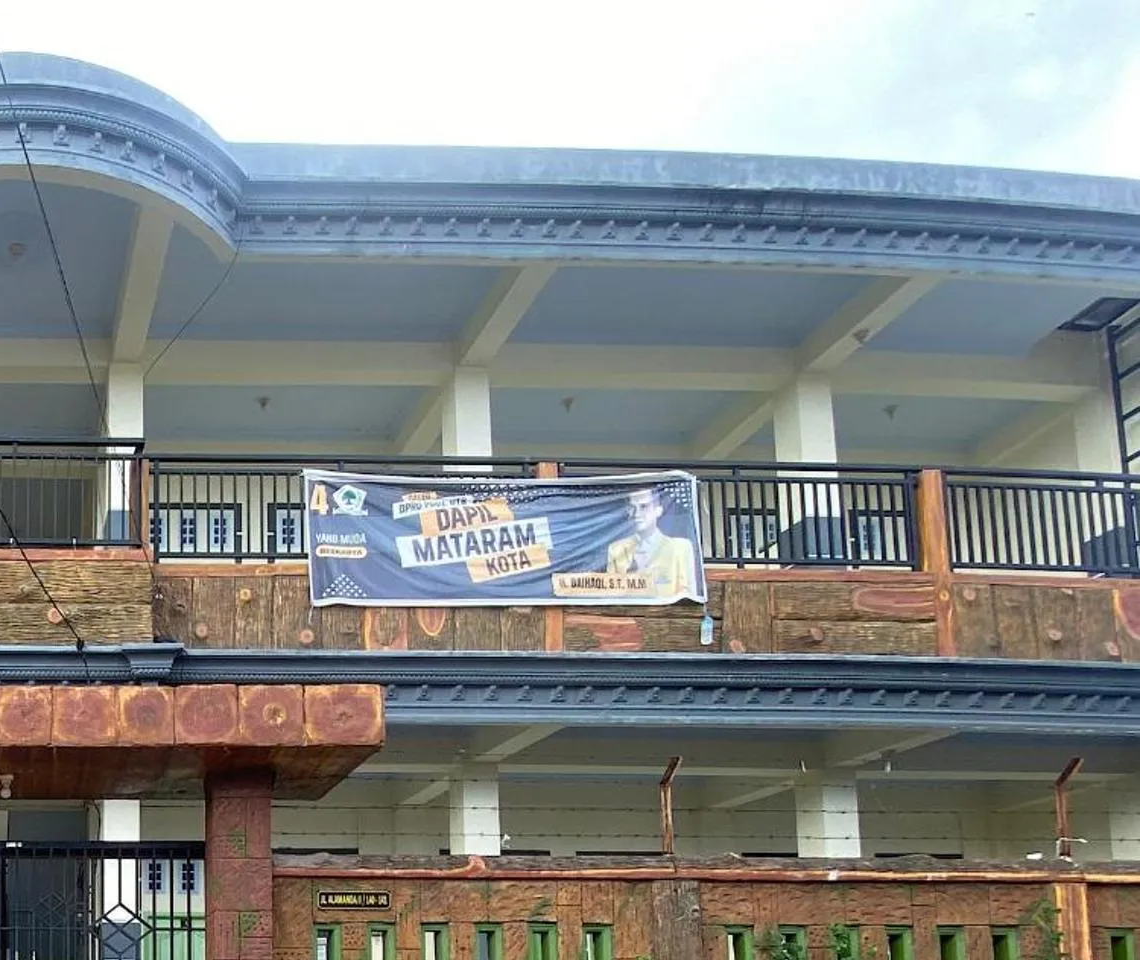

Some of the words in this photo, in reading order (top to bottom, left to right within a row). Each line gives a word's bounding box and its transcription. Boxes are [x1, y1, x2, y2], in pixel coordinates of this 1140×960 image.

[310, 484, 329, 515] 4
[435, 505, 498, 531] DAPIL
[412, 523, 536, 562] MATARAM
[485, 550, 531, 576] KOTA
